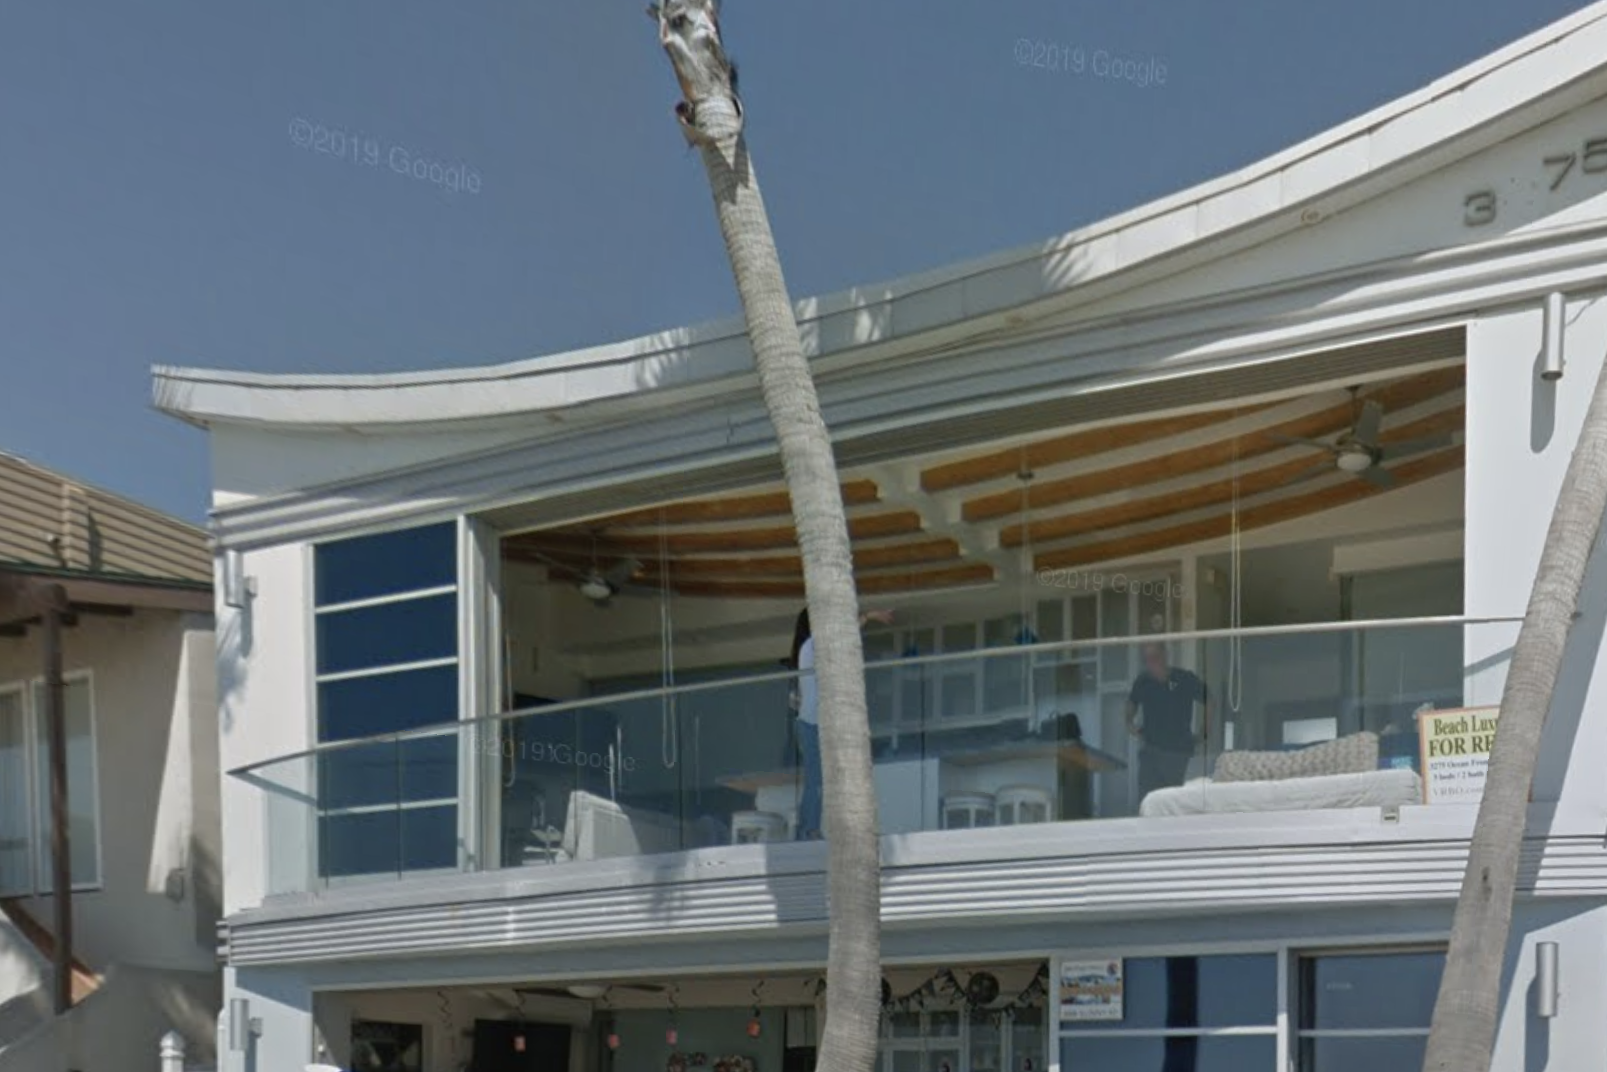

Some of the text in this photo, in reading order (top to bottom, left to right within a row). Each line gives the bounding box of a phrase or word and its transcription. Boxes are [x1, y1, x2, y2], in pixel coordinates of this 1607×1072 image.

[1434, 716, 1468, 736] Beach
[1429, 734, 1495, 757] FOR RE
